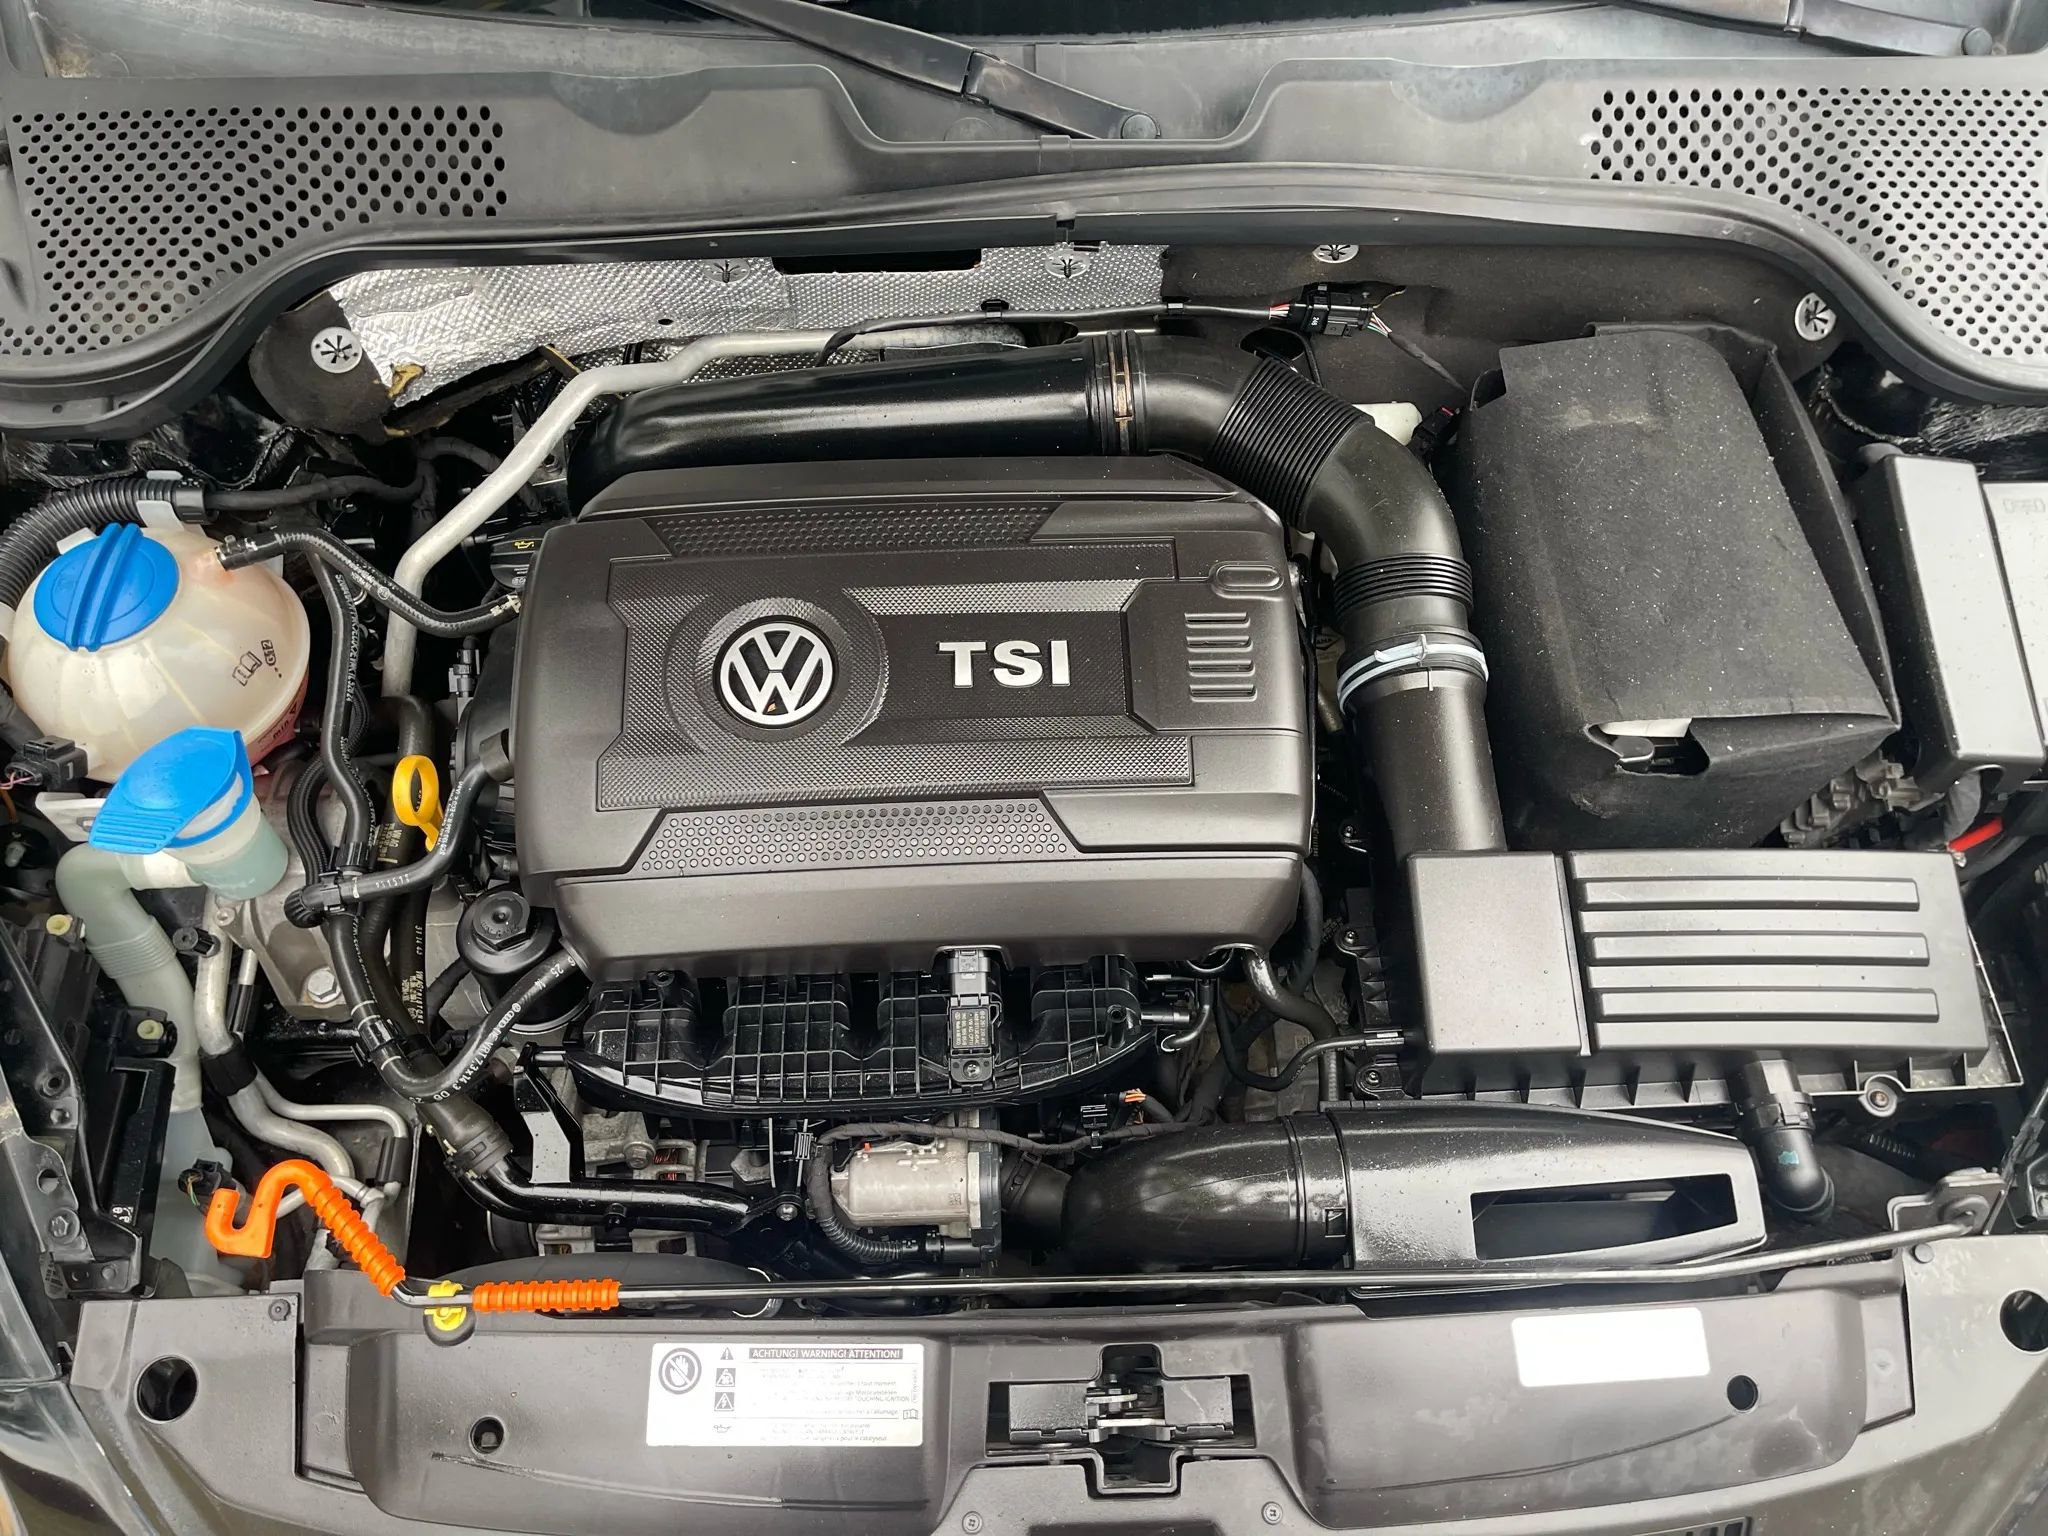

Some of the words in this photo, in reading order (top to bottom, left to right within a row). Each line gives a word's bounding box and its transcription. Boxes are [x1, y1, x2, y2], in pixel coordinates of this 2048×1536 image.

[938, 640, 1070, 688] TSI
[550, 963, 564, 978] 25
[752, 1349, 798, 1358] ACHTUNG!
[800, 1349, 847, 1358] WARNING!
[850, 1348, 900, 1358] ATTENTION!
